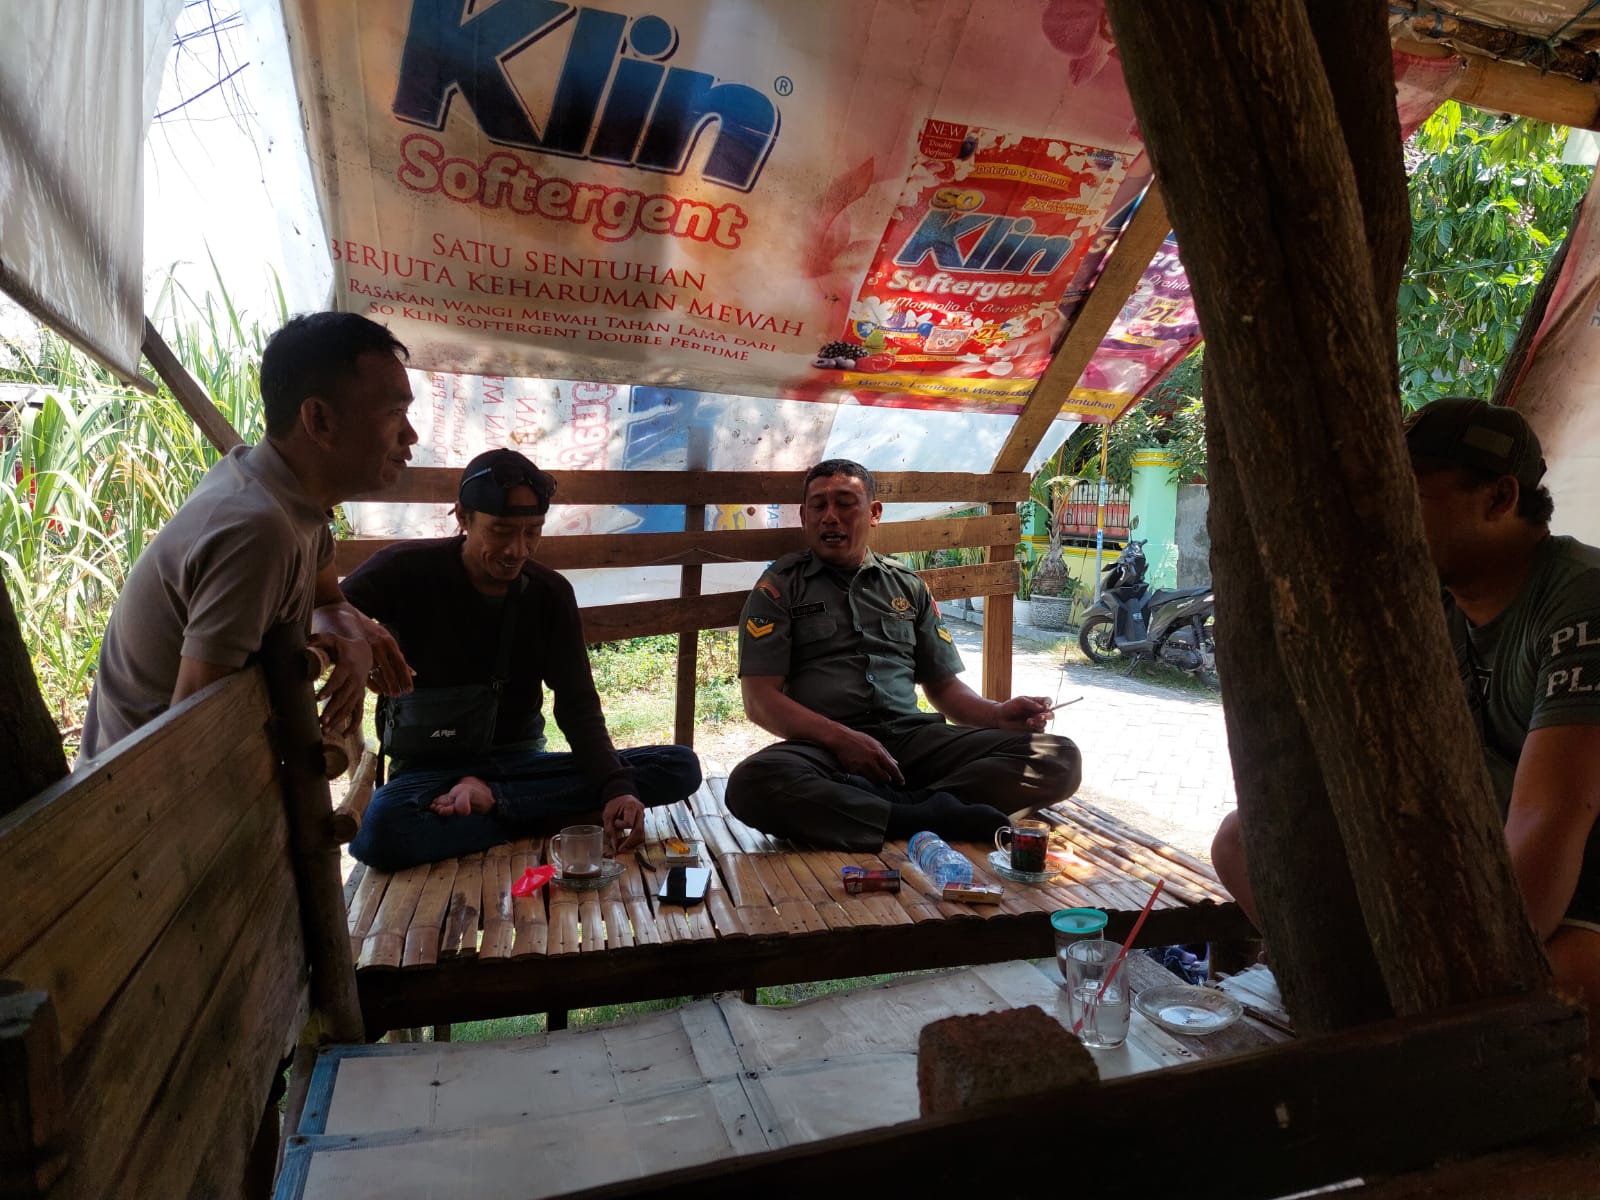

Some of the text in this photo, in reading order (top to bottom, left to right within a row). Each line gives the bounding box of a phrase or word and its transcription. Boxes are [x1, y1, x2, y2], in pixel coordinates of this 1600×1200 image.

[392, 0, 781, 193] Klin
[929, 122, 963, 137] NEW
[397, 133, 749, 249] Softergent
[977, 165, 1019, 177] Deterjen
[1028, 171, 1068, 186] Softener
[432, 233, 706, 291] SATU SENTUHAN
[893, 208, 1075, 276] Klin
[468, 271, 677, 311] KEHARUMAN
[688, 298, 804, 337] MEWAH
[887, 269, 1047, 301] Softergent
[893, 296, 961, 312] Magnolia
[980, 303, 1030, 313] Berries
[1142, 307, 1174, 321] 21
[350, 279, 776, 352] RASAKAN WANGI MEWAH TAHAN LAMA DARI
[369, 302, 749, 361] SO KLIN SOFTERGENT DOUBLE PERFUME
[1549, 621, 1600, 657] PL
